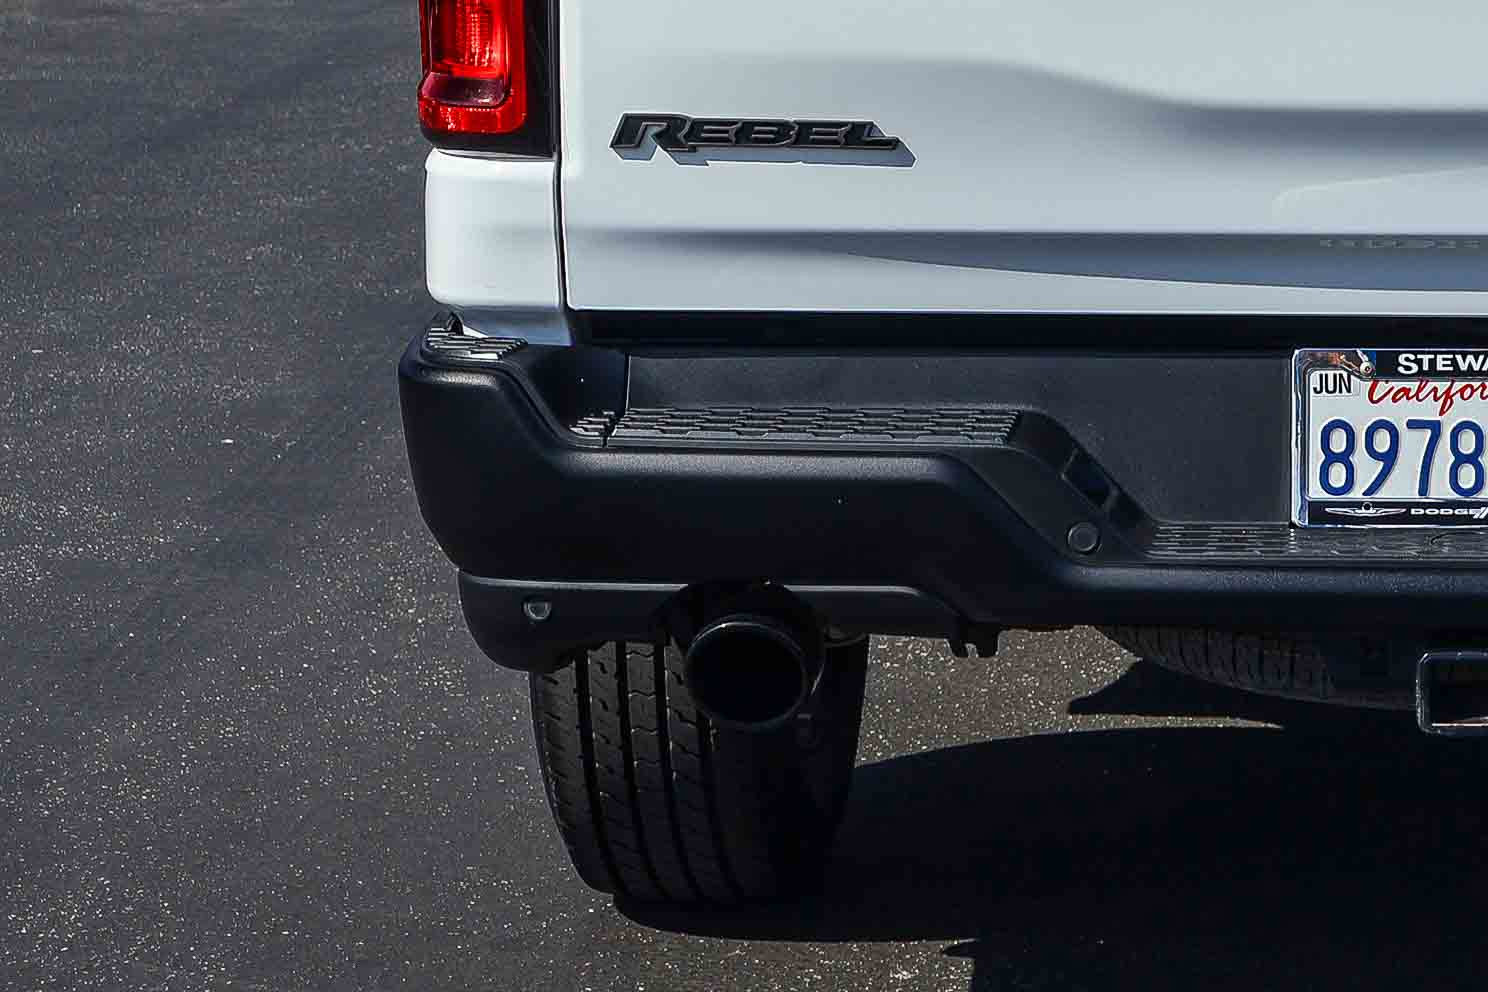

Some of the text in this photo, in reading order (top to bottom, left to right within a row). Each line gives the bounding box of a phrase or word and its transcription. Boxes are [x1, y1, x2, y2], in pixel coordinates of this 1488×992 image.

[609, 112, 903, 154] REBEL
[1313, 373, 1351, 395] JUN
[1411, 508, 1480, 516] DODGE
